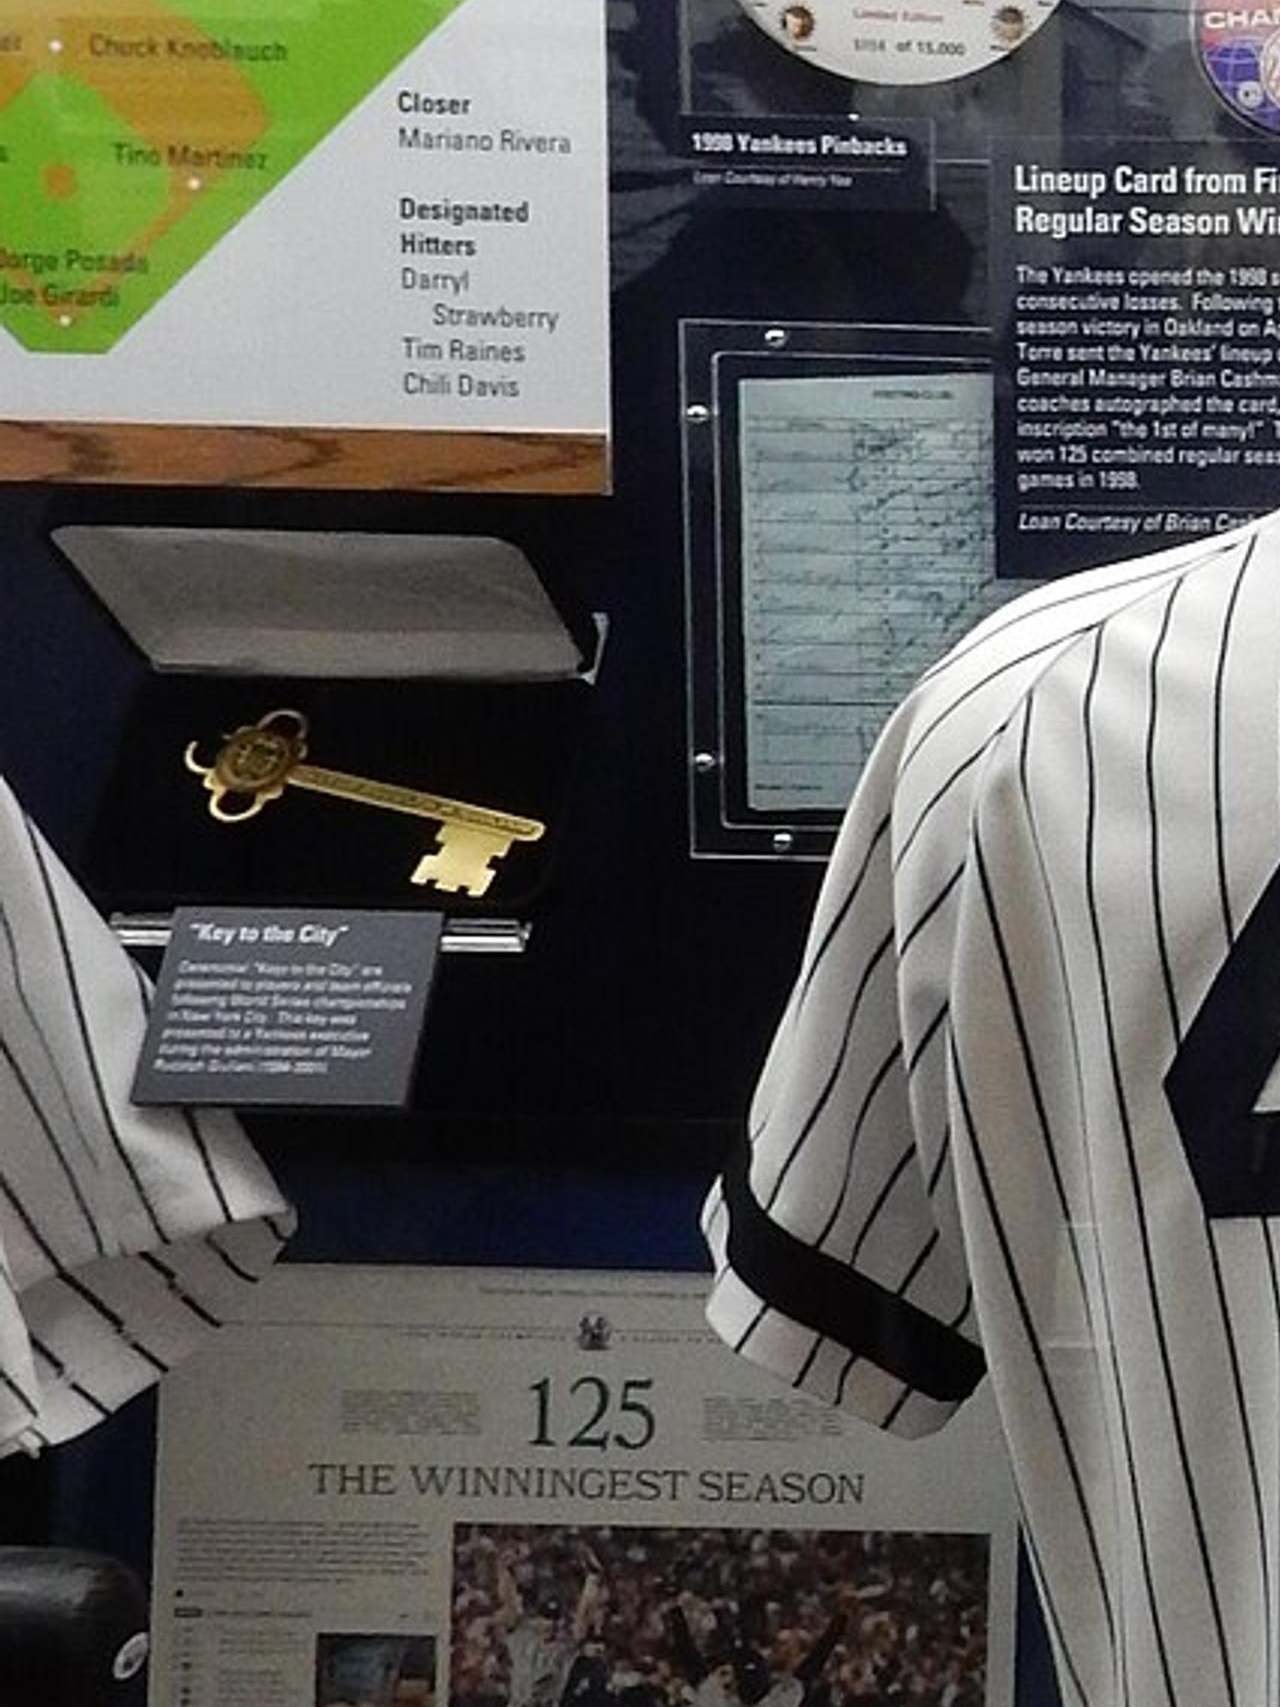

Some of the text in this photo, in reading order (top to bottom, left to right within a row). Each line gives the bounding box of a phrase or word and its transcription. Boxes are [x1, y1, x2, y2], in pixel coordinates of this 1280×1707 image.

[398, 91, 470, 115] Closer
[399, 126, 570, 154] Mariano Rivera
[693, 132, 907, 156] 1998 Yankees Pinbacks
[1016, 164, 1105, 200] Lineup
[1115, 166, 1177, 193] Card
[1185, 166, 1246, 194] from
[400, 197, 528, 226] Designated
[1016, 206, 1122, 239] Regular
[1130, 206, 1229, 235] Season
[401, 233, 476, 256] Hitters
[402, 266, 469, 296] Darryl
[1016, 265, 1048, 285] The
[1052, 267, 1125, 285] Yankees
[1129, 268, 1192, 288] opened
[1197, 269, 1224, 286] the
[1230, 267, 1267, 286] 1998
[433, 303, 559, 333] Strawberry
[403, 336, 525, 363] Tim Raines
[404, 372, 519, 398] Chili Davis
[239, 927, 259, 942] to
[263, 925, 294, 943] the
[530, 1376, 654, 1452] 125
[308, 1462, 864, 1505] THE WINNINGEST SEASON
